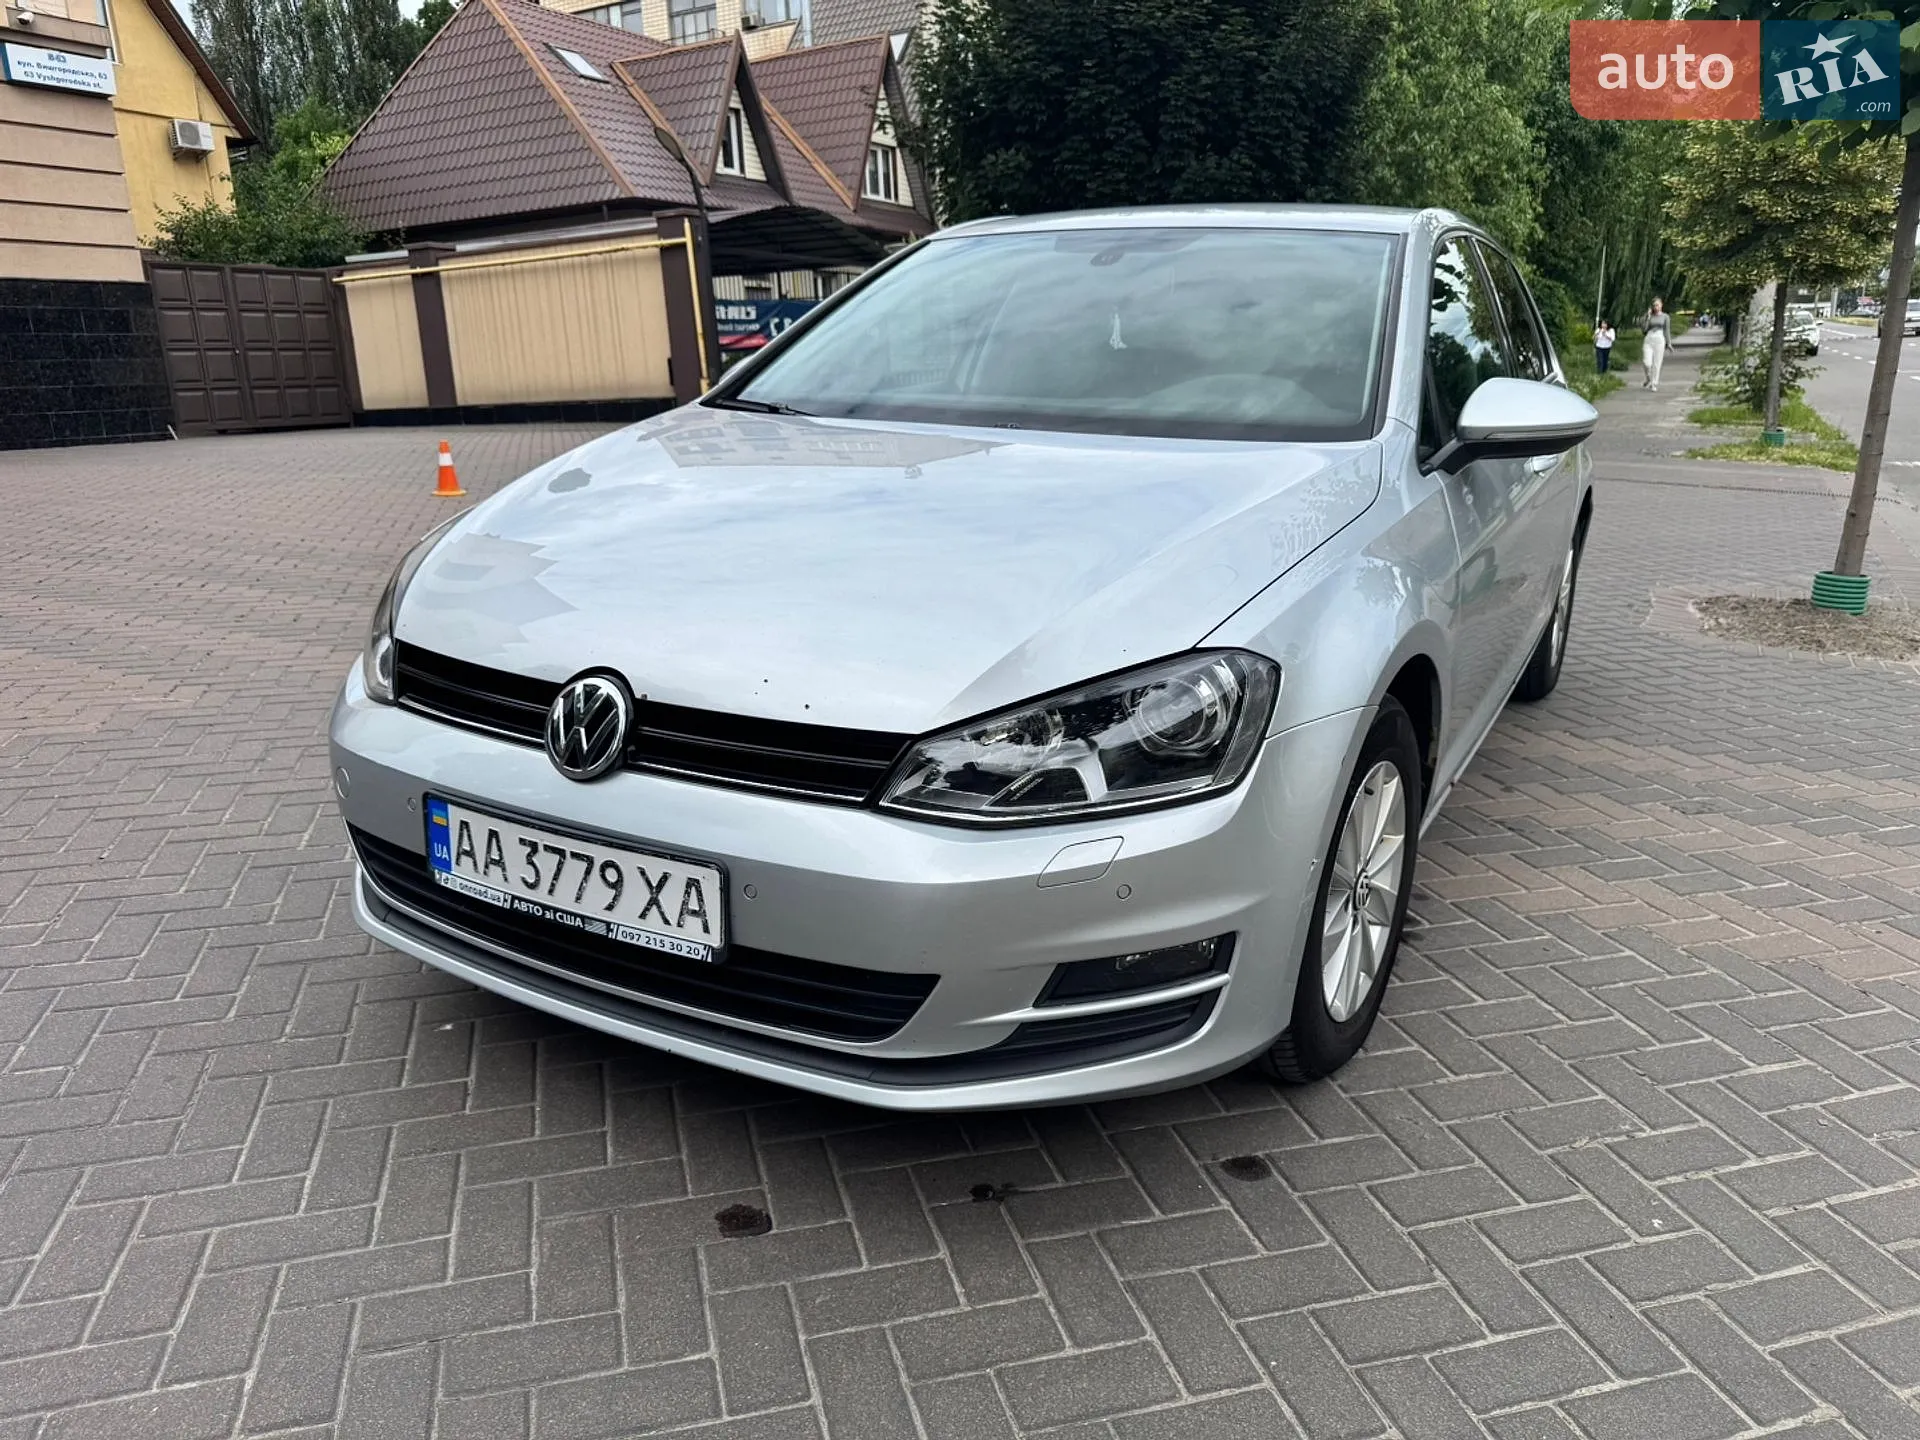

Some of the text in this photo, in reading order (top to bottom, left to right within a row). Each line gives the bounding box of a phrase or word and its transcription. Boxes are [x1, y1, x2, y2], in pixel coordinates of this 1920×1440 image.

[24, 70, 35, 79] 63
[37, 71, 91, 87] Vyshgorodska
[434, 841, 450, 861] UA
[455, 819, 711, 935] AA 3779 XA
[513, 900, 543, 917] АВТО
[556, 912, 584, 929] США
[621, 930, 700, 957] 097 215 30 20
